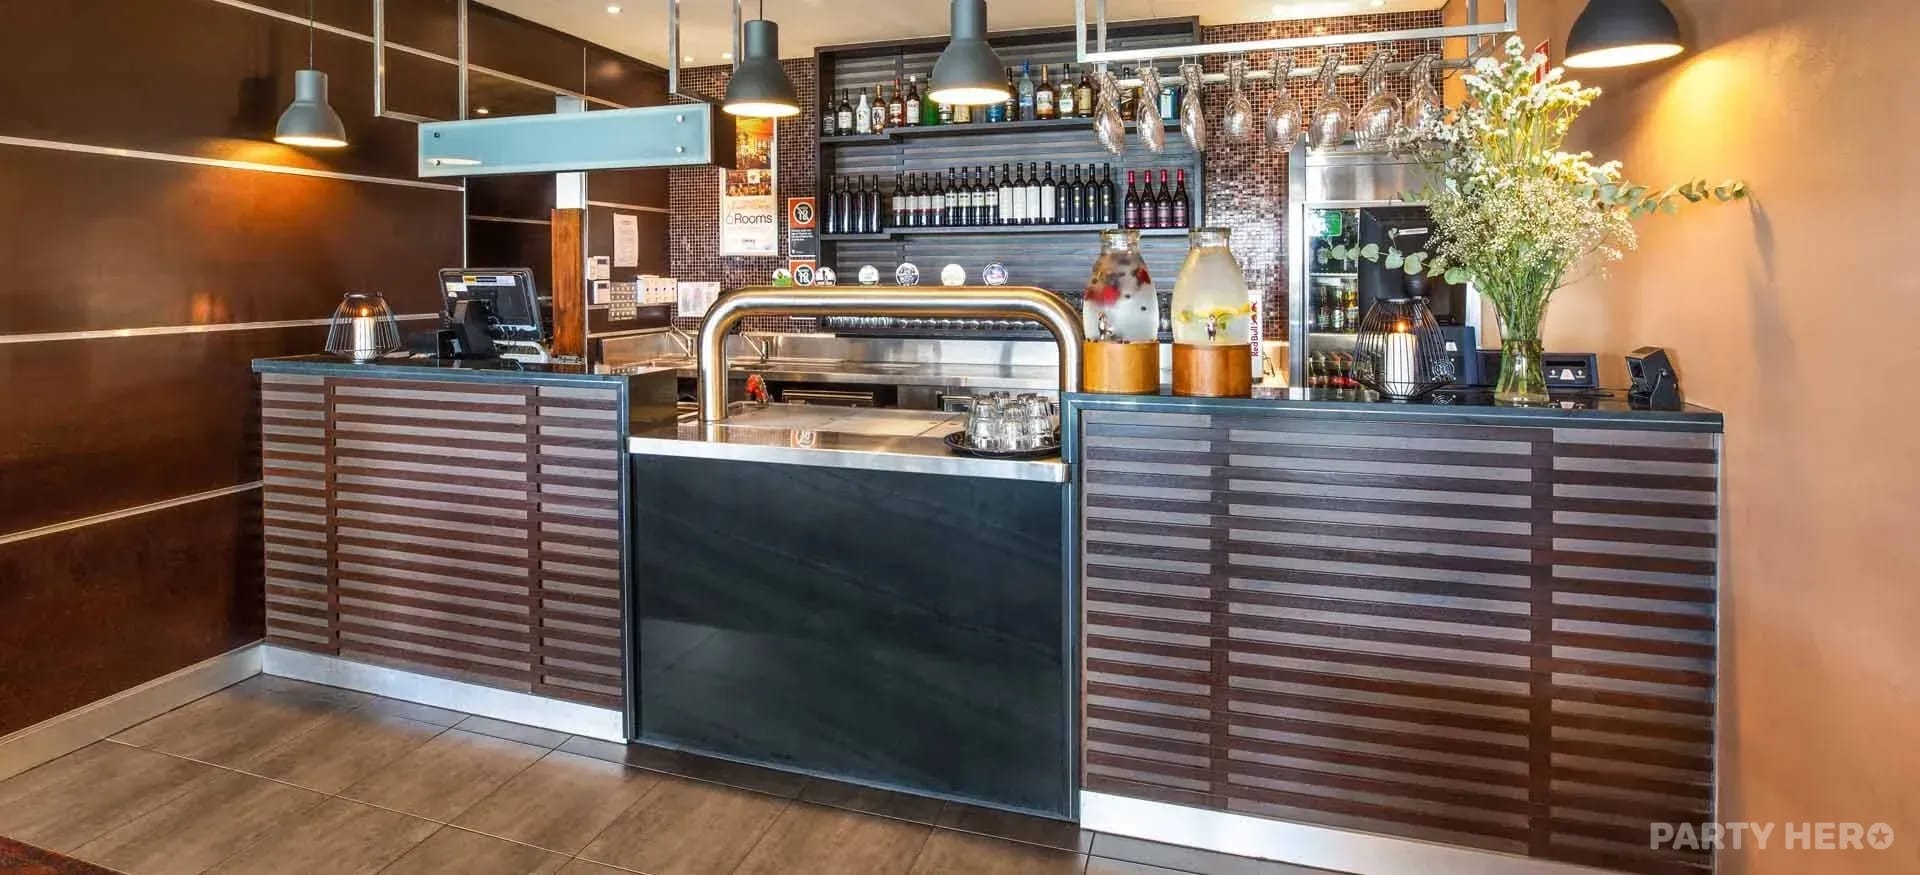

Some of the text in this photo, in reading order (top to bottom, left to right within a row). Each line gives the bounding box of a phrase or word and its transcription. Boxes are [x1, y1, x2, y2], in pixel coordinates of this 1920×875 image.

[735, 213, 772, 225] Rooms
[1250, 326, 1259, 357] Red Bull
